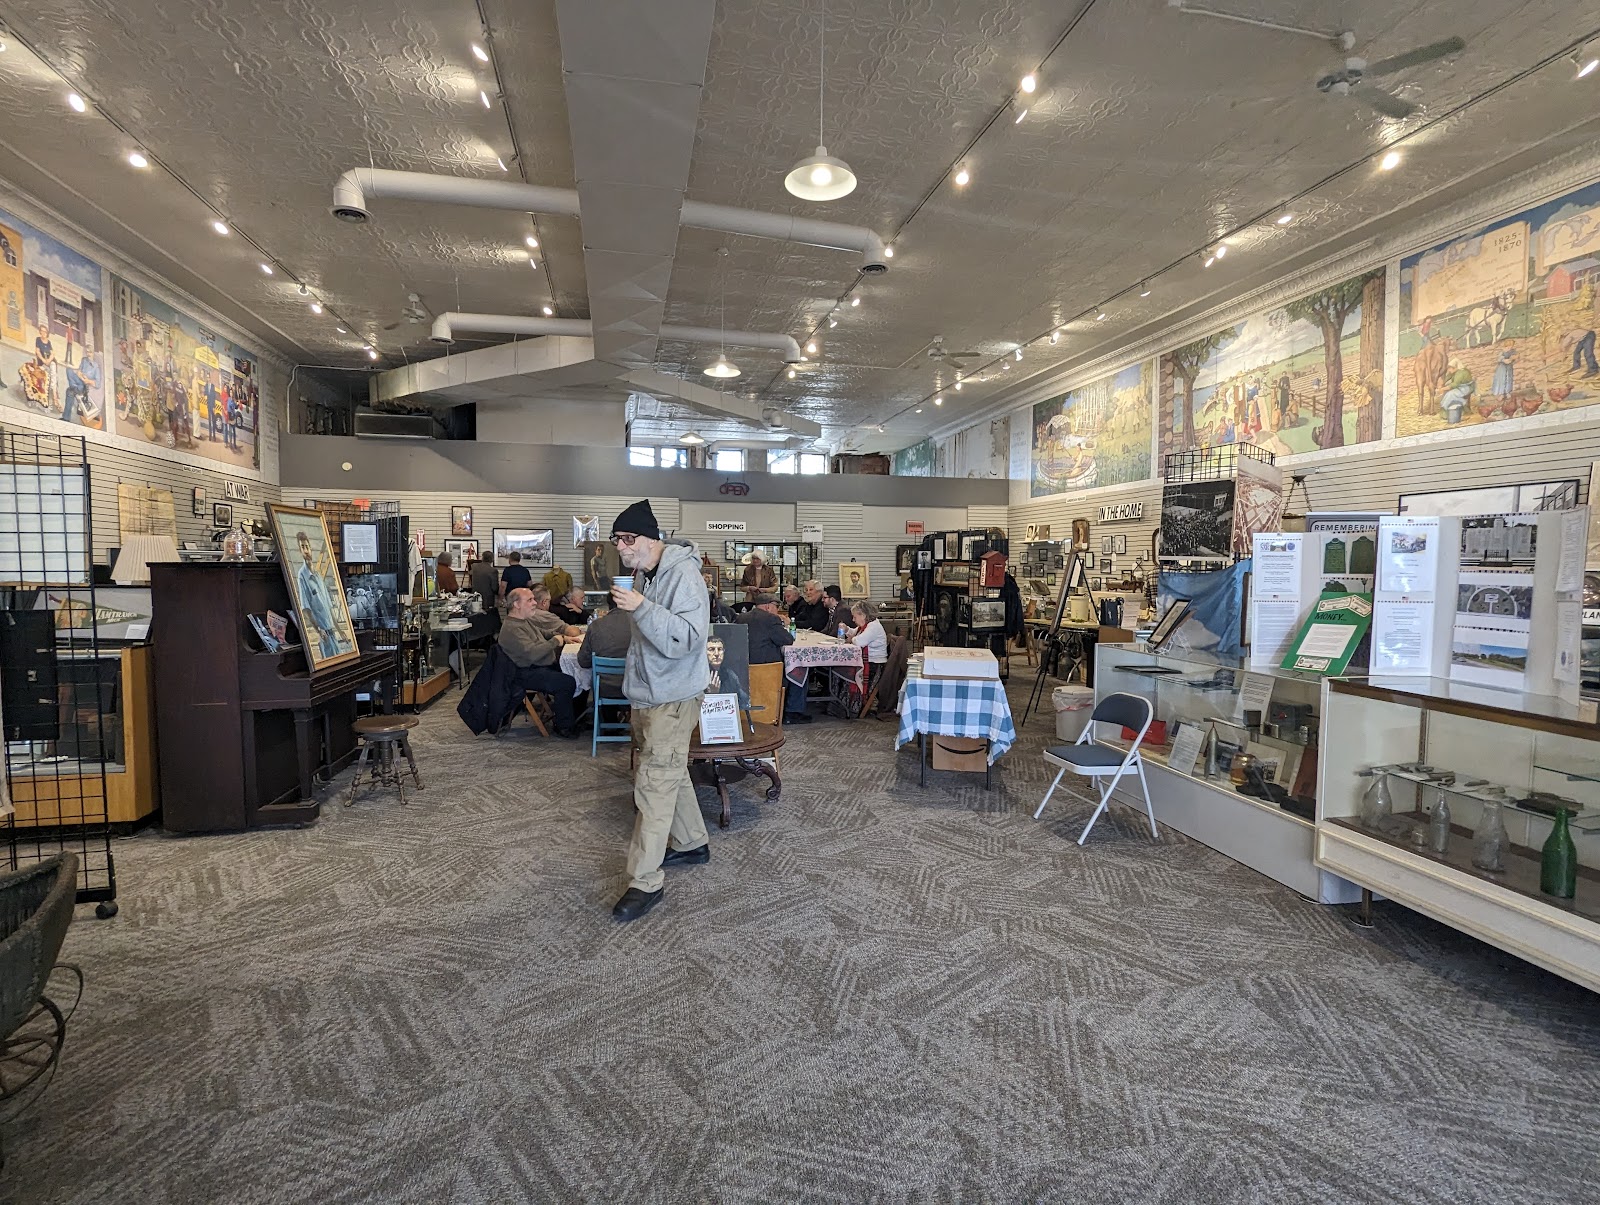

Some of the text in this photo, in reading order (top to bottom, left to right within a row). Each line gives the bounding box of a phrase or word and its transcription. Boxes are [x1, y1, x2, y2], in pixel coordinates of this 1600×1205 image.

[1494, 232, 1522, 247] 1825-
[1498, 239, 1522, 253] 1870
[226, 481, 249, 499] AT WAR
[719, 483, 749, 496] OPEN
[1099, 503, 1142, 520] IN THE HOME
